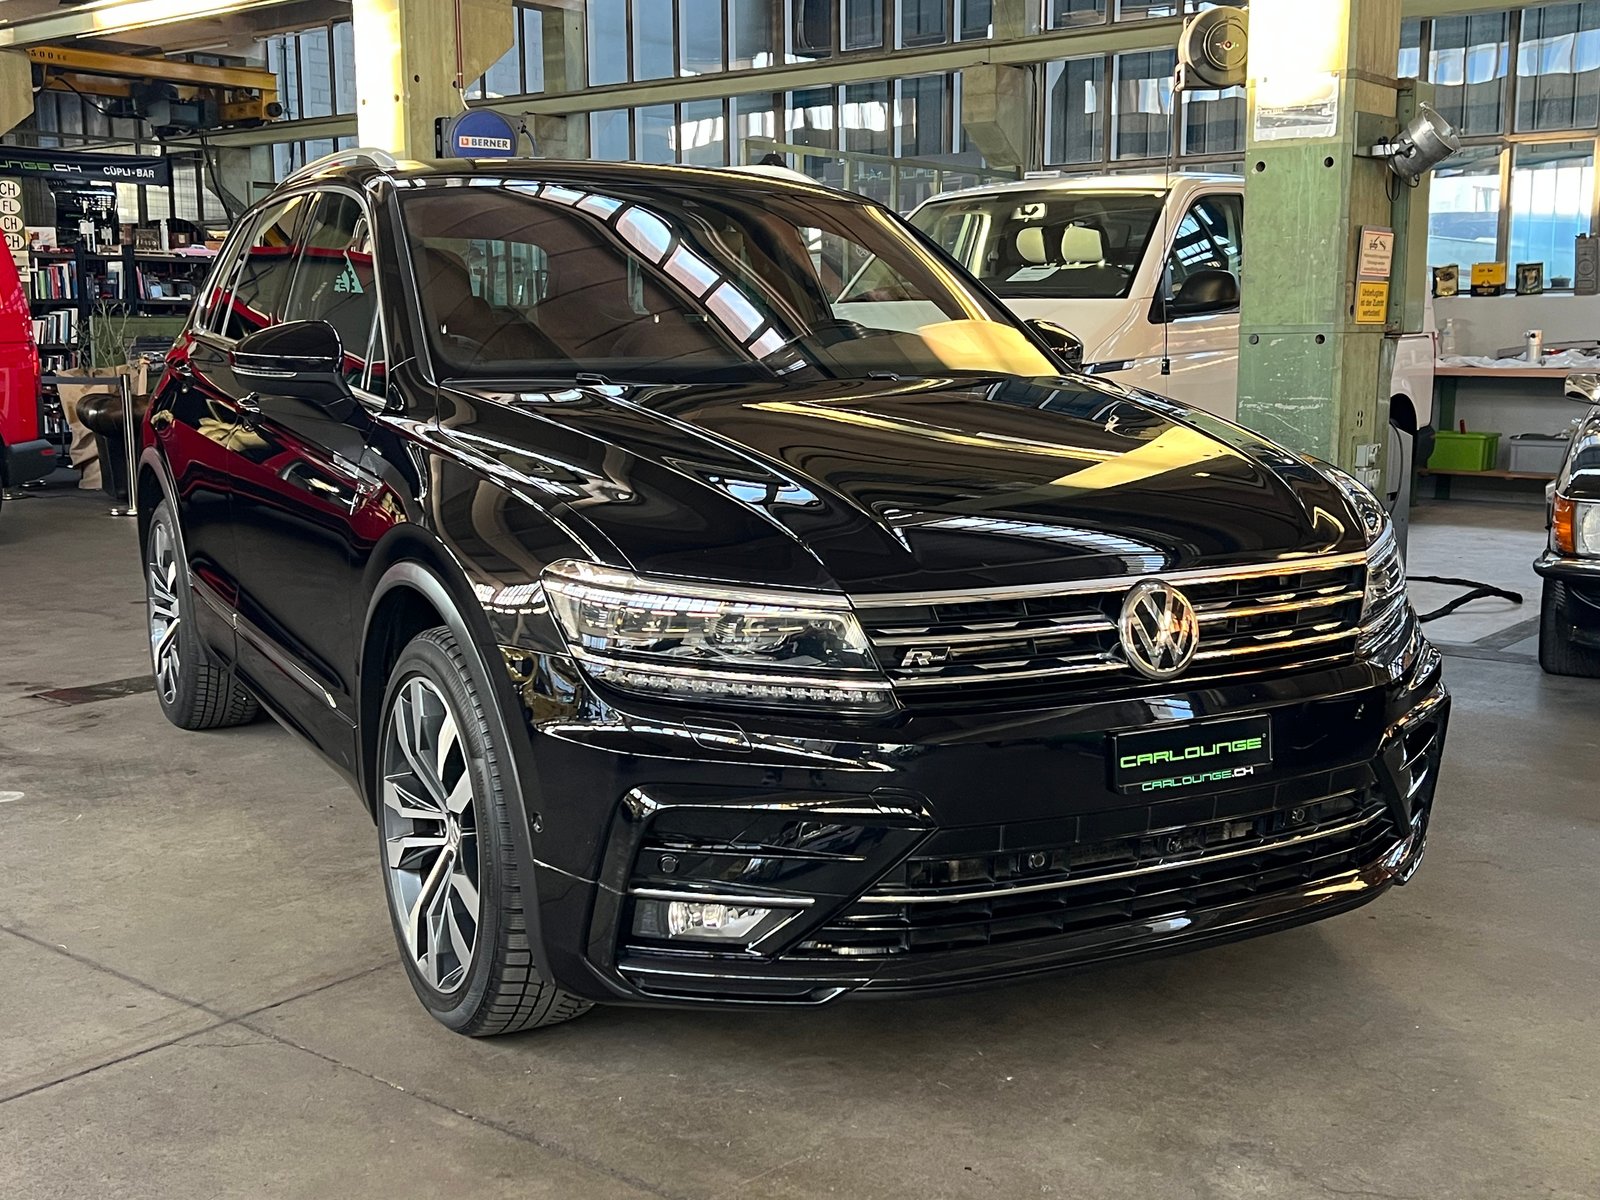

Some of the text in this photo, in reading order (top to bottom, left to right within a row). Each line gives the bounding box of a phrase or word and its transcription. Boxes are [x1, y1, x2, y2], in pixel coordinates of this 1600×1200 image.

[471, 138, 508, 149] BERNER
[0, 182, 16, 196] CH
[2, 200, 16, 212] FL
[3, 217, 18, 230] CH
[1120, 737, 1262, 768] CARLOUNGE
[1141, 766, 1254, 792] CARLOUNGE.CH
